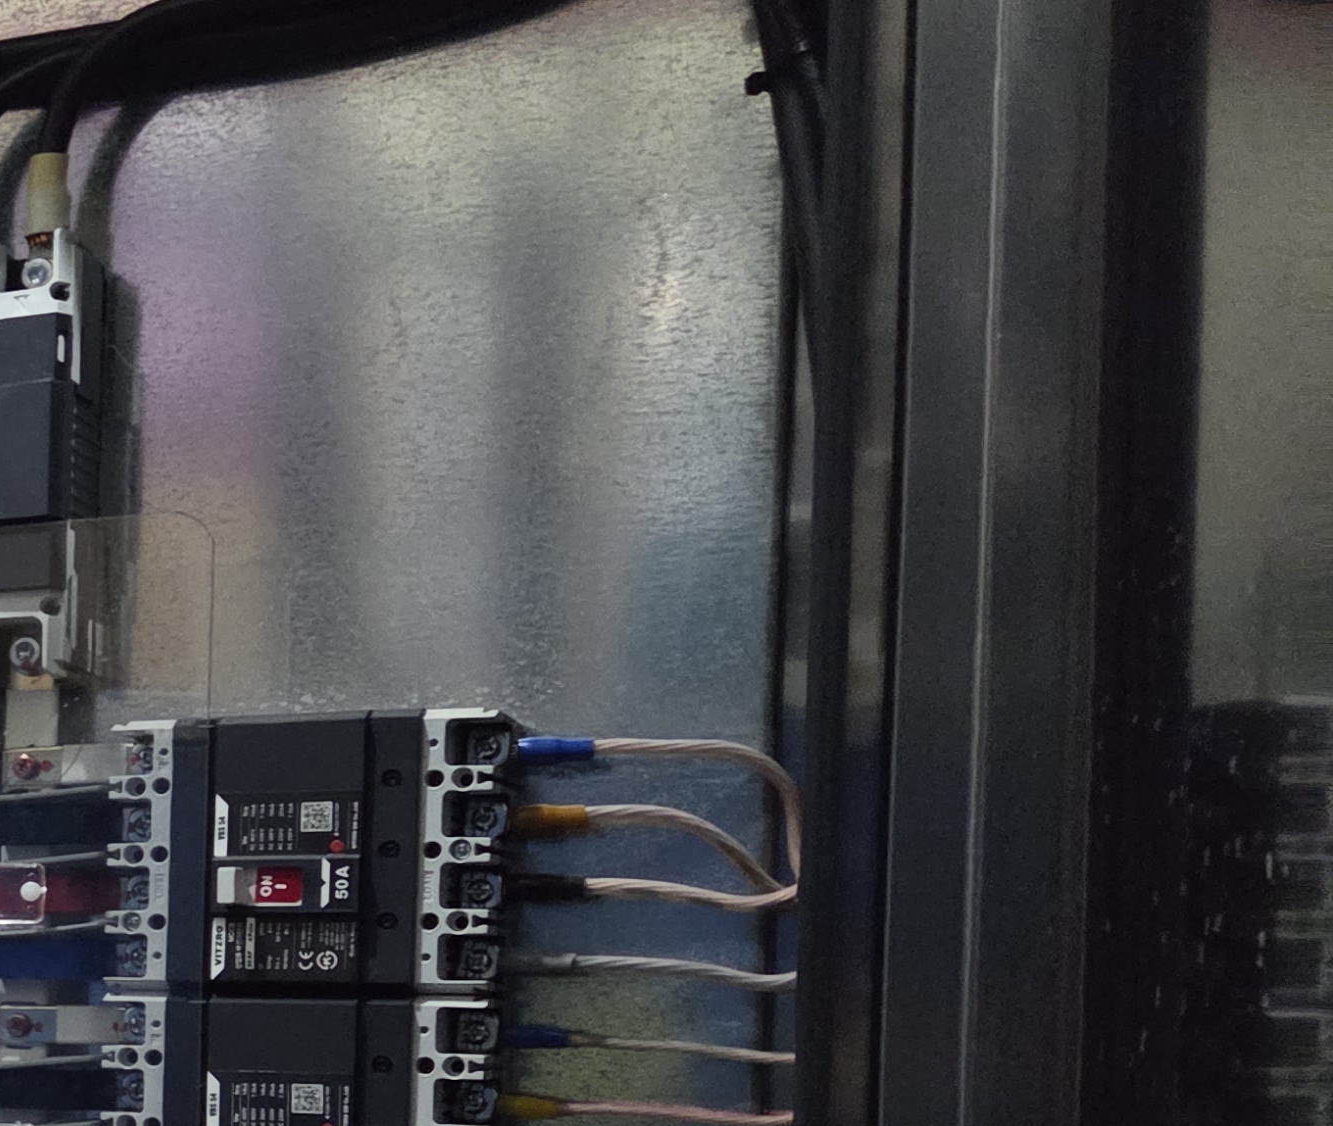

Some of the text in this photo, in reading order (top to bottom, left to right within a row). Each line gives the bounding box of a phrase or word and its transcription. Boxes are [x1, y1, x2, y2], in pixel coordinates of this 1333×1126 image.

[259, 875, 273, 898] ON
[335, 865, 350, 900] 50A
[215, 925, 224, 967] VITZRO
